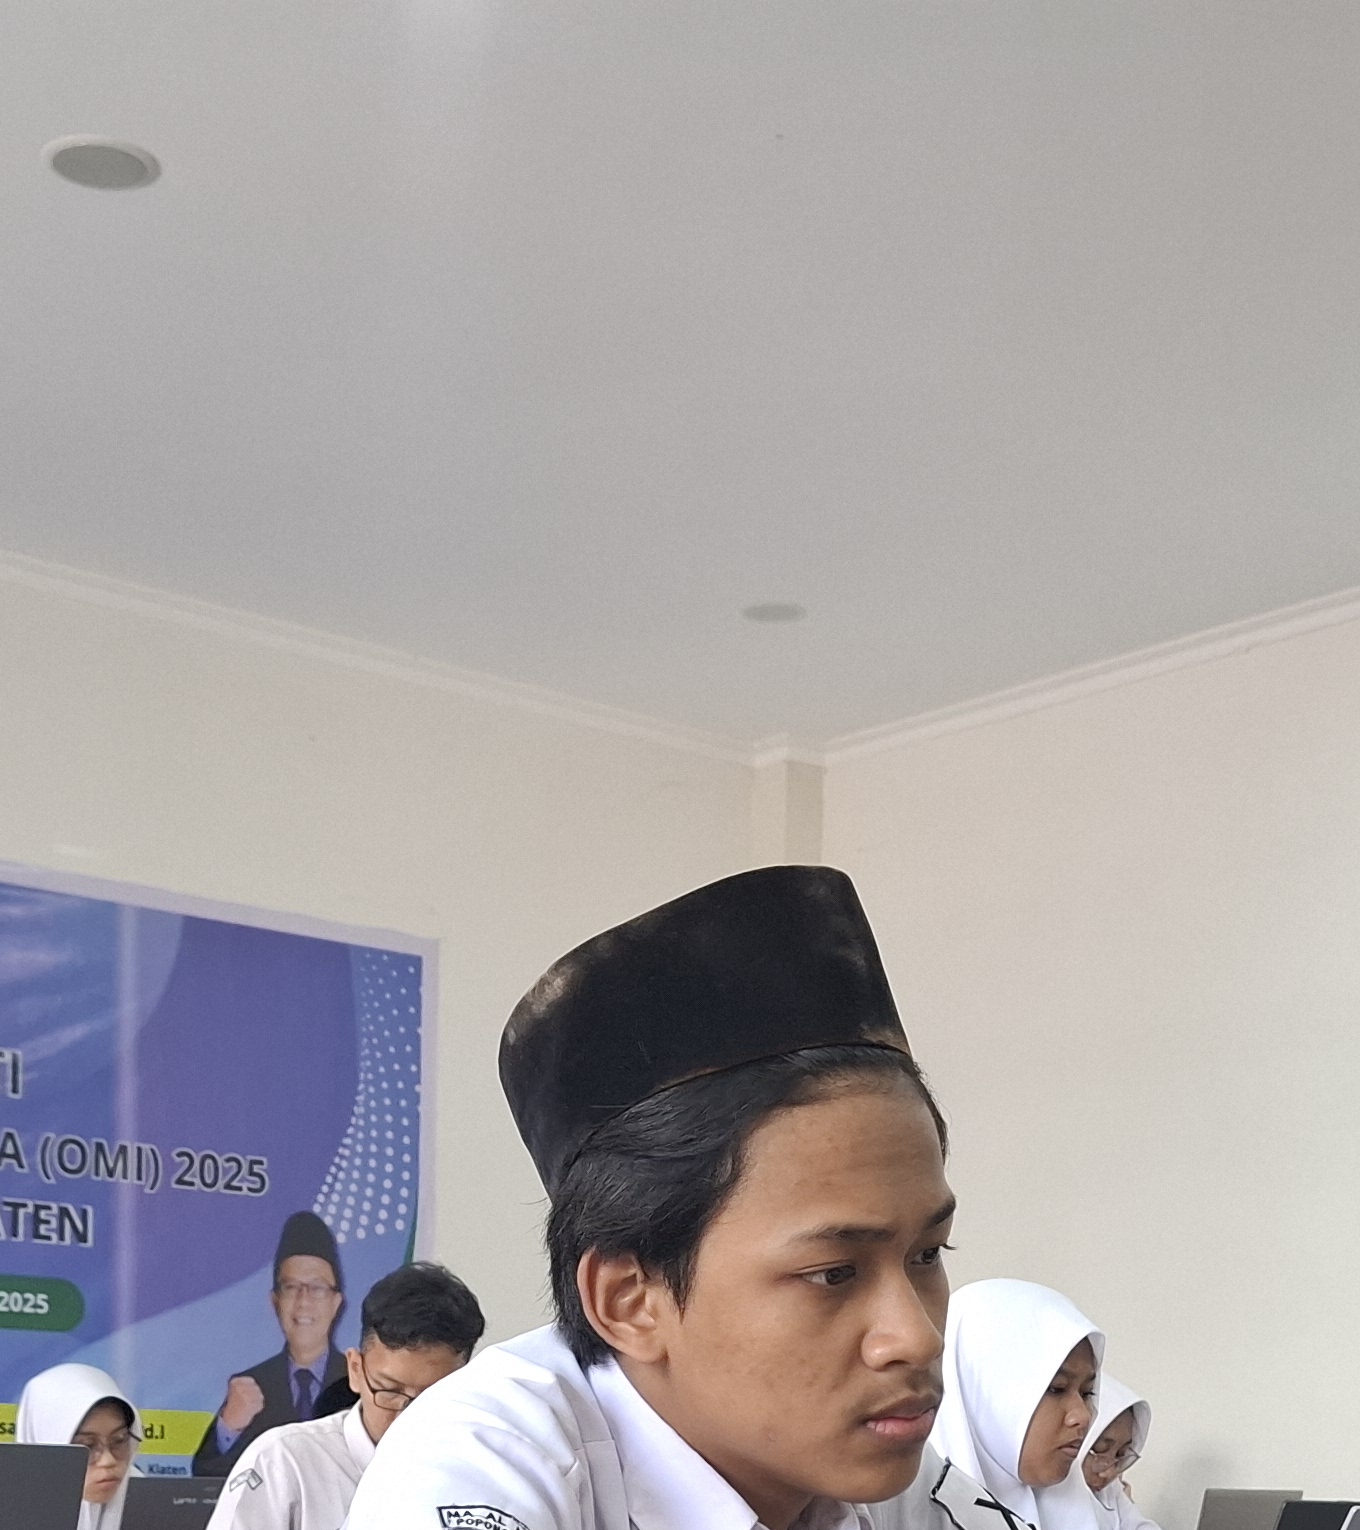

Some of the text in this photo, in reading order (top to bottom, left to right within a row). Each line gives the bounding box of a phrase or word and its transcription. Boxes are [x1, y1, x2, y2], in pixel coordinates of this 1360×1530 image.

[39, 1135, 160, 1191] (OMI)
[173, 1150, 269, 1195] 2025
[447, 1510, 473, 1519] MA
[486, 1512, 507, 1526] AL
